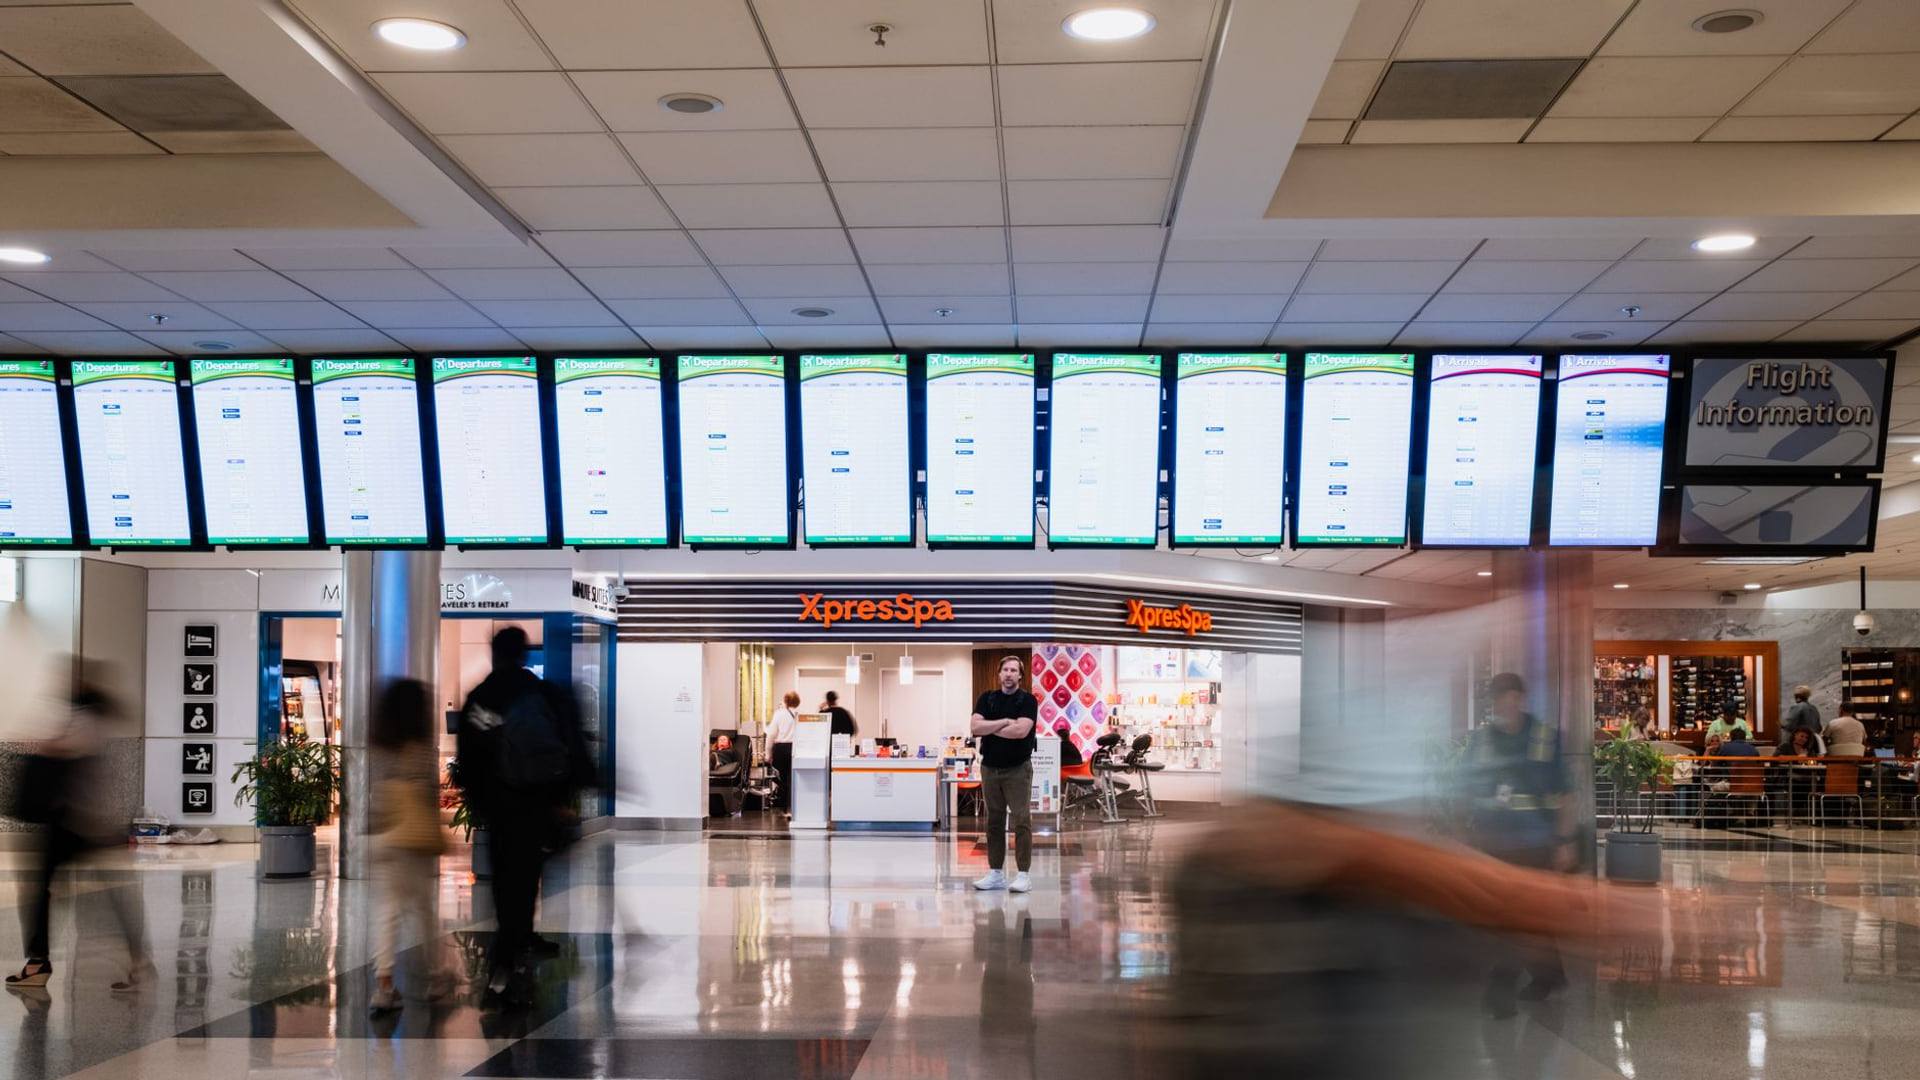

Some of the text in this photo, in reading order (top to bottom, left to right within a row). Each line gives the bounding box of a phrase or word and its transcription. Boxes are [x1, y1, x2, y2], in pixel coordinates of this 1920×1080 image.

[204, 361, 259, 371] Departures
[325, 360, 380, 371] Departures
[447, 359, 502, 370] Departures
[570, 359, 625, 370] Departures
[693, 357, 749, 367] Departures
[815, 356, 871, 367] Departures
[942, 356, 999, 367] Departures
[1070, 356, 1126, 367] Departures
[1194, 355, 1251, 366] Departures
[1321, 355, 1378, 366] Departures
[1448, 357, 1489, 366] Arrivals
[1575, 357, 1617, 366] Arrivals
[86, 363, 140, 373] Departures
[1747, 362, 1832, 395] Flight
[1697, 399, 1873, 426] Information
[799, 593, 955, 629] XpresSpa
[1126, 599, 1213, 636] XpresSpa
